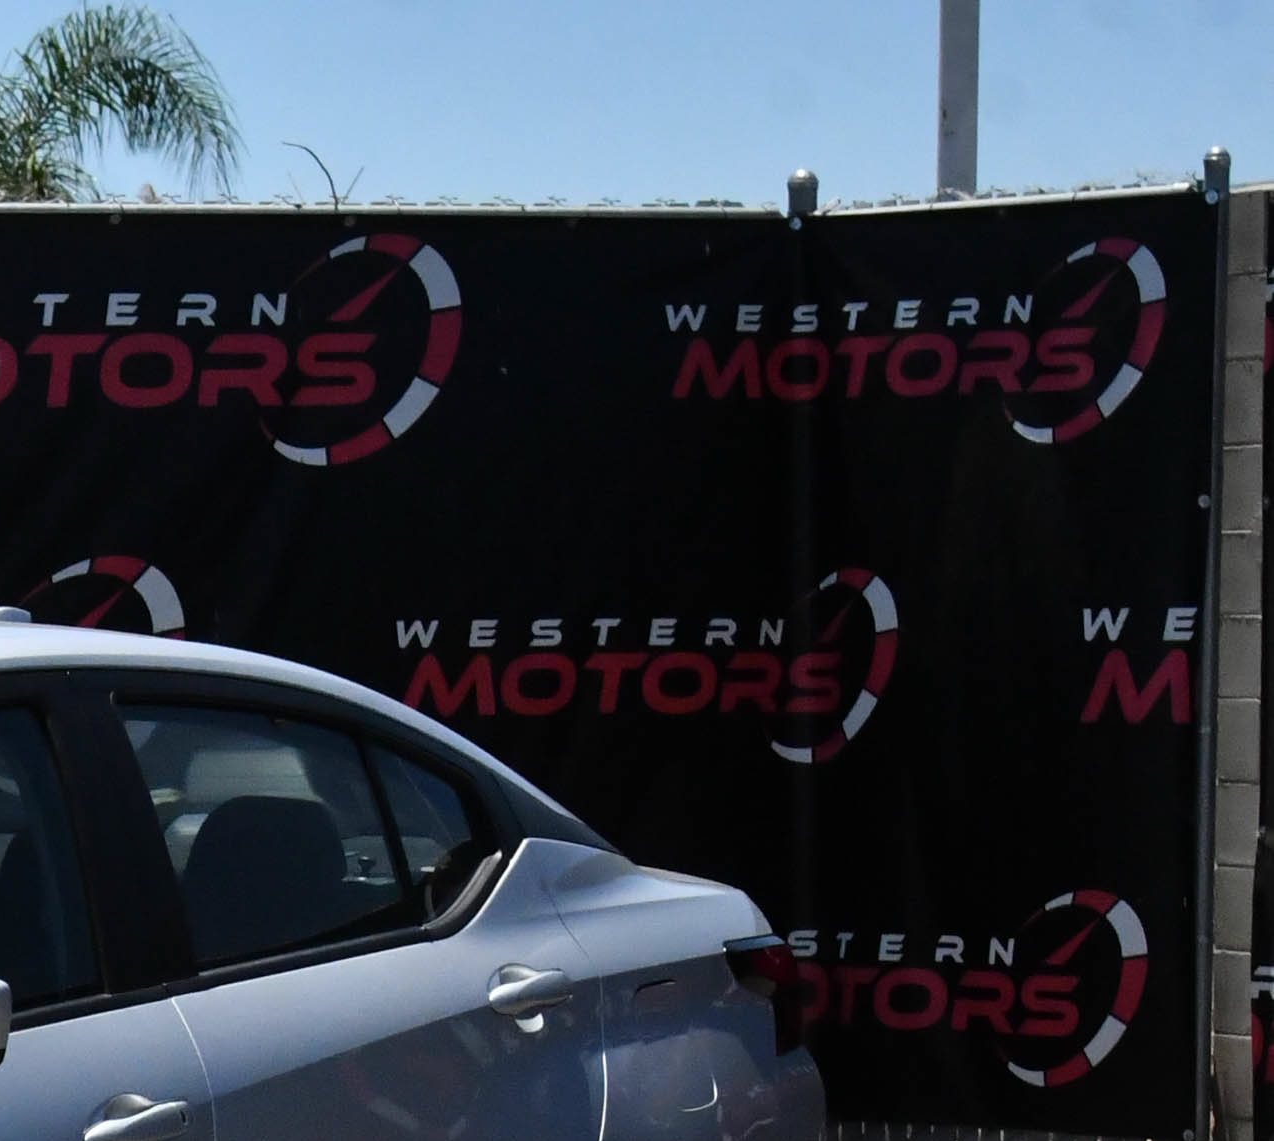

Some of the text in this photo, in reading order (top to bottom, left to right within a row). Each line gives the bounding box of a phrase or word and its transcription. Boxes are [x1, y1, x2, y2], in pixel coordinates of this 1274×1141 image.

[666, 295, 1033, 333] WESTERN
[672, 327, 1095, 400] MOTORS
[396, 618, 784, 648] WESTERN
[404, 652, 842, 718] MOTORS
[787, 930, 1015, 966] STERN
